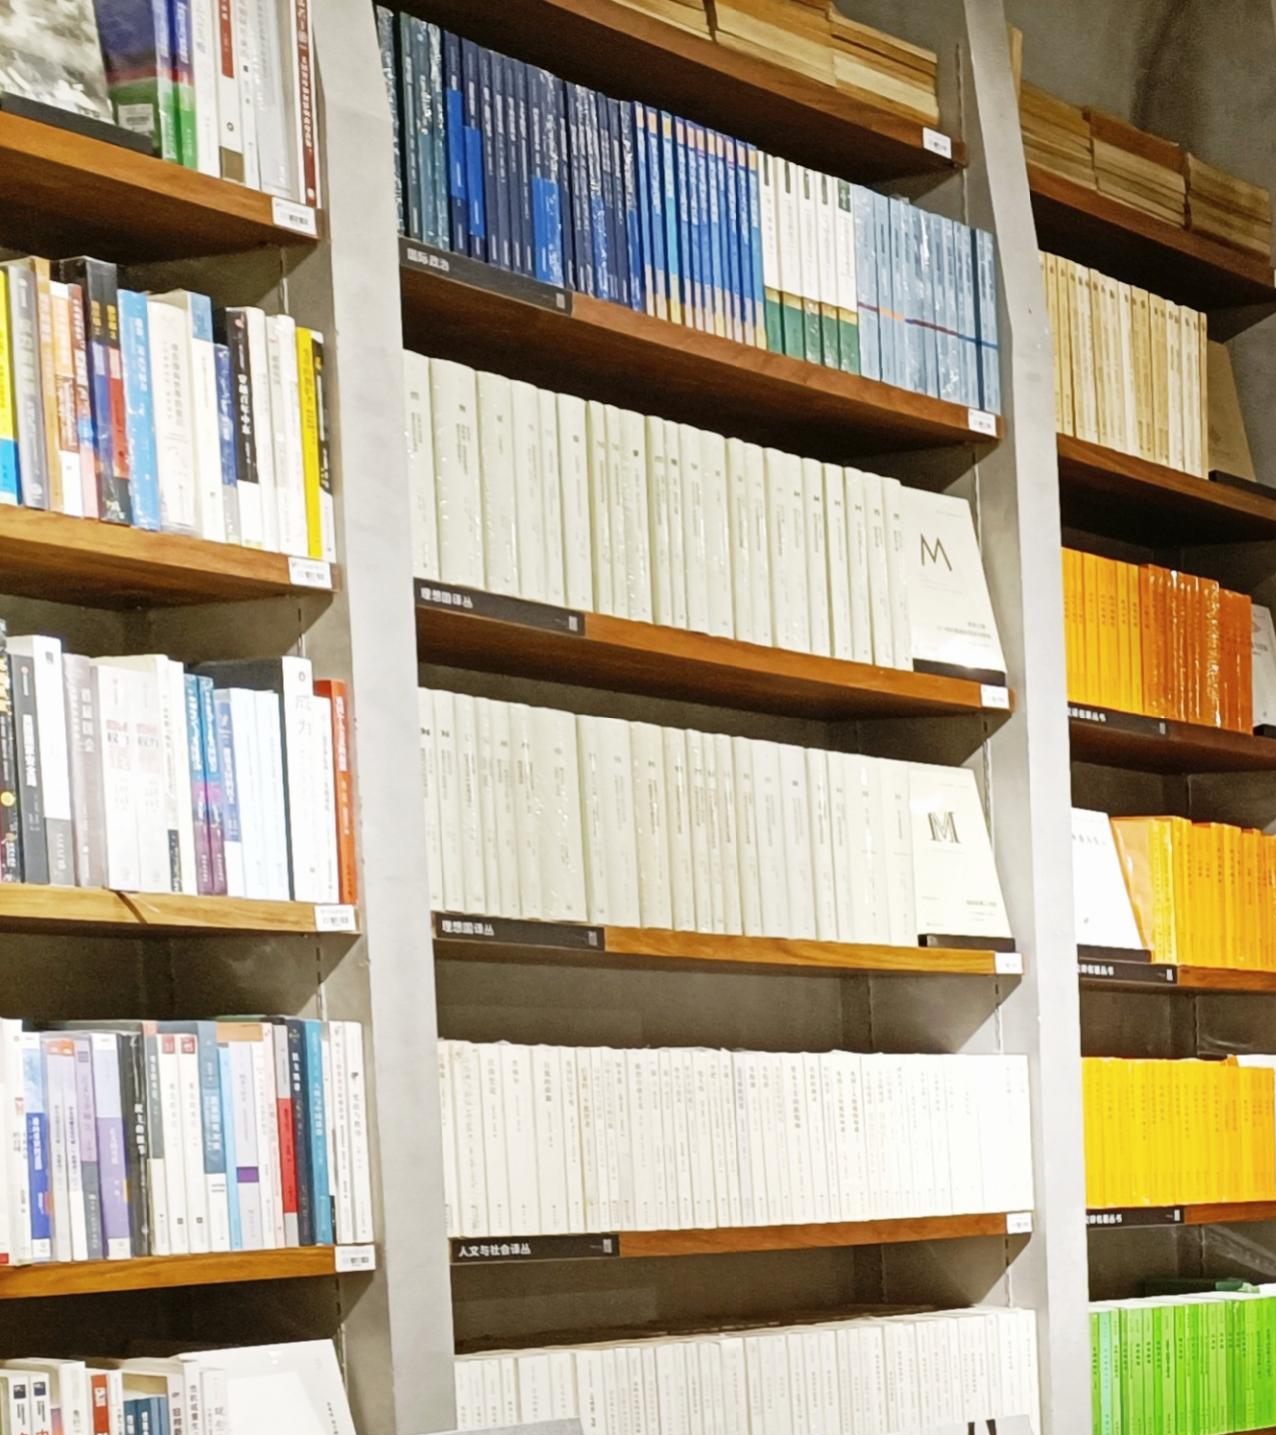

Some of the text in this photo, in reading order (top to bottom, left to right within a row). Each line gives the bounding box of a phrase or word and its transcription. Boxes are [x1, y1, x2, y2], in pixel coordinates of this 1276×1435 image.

[920, 532, 952, 572] M
[458, 1242, 532, 1259] 人文与社会译丛
